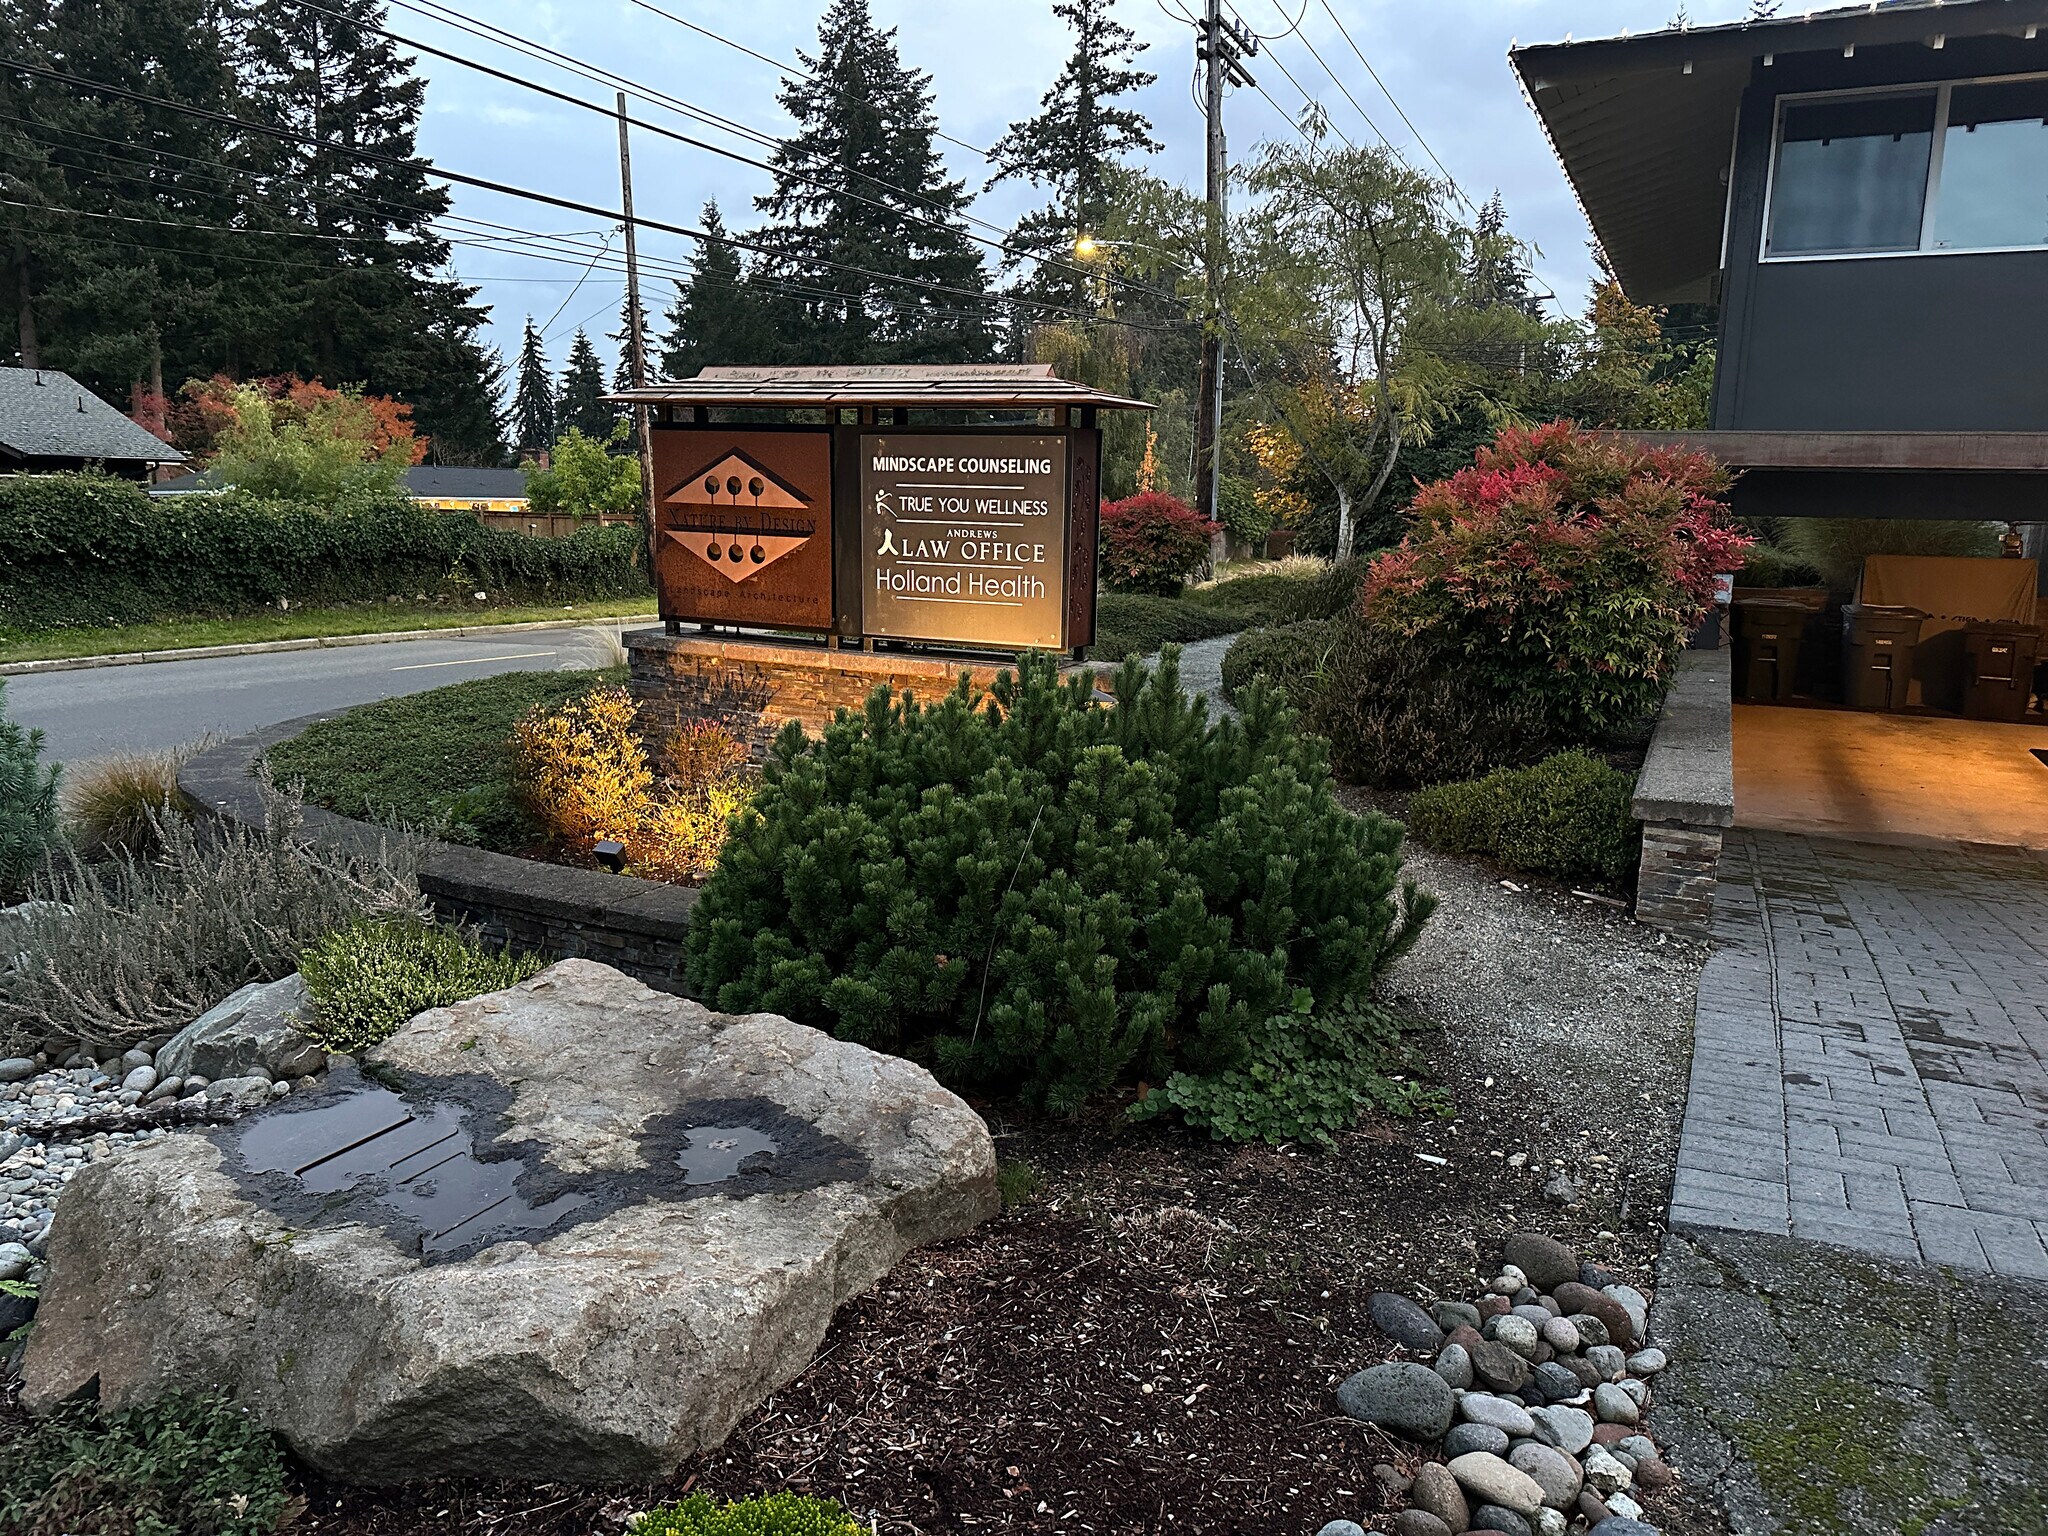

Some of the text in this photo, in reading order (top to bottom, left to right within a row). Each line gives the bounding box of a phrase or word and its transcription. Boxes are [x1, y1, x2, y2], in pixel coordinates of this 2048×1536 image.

[873, 456, 1051, 474] MINDSCAPE COUNSELING
[899, 496, 1048, 516] TRUE YOU WELLNESS
[760, 511, 817, 534] DESIGN
[946, 529, 998, 539] ANDREWS
[902, 539, 1045, 563] LAW OFFICE
[876, 568, 1045, 599] Holland Health
[669, 585, 819, 605] Landscape Architecture
